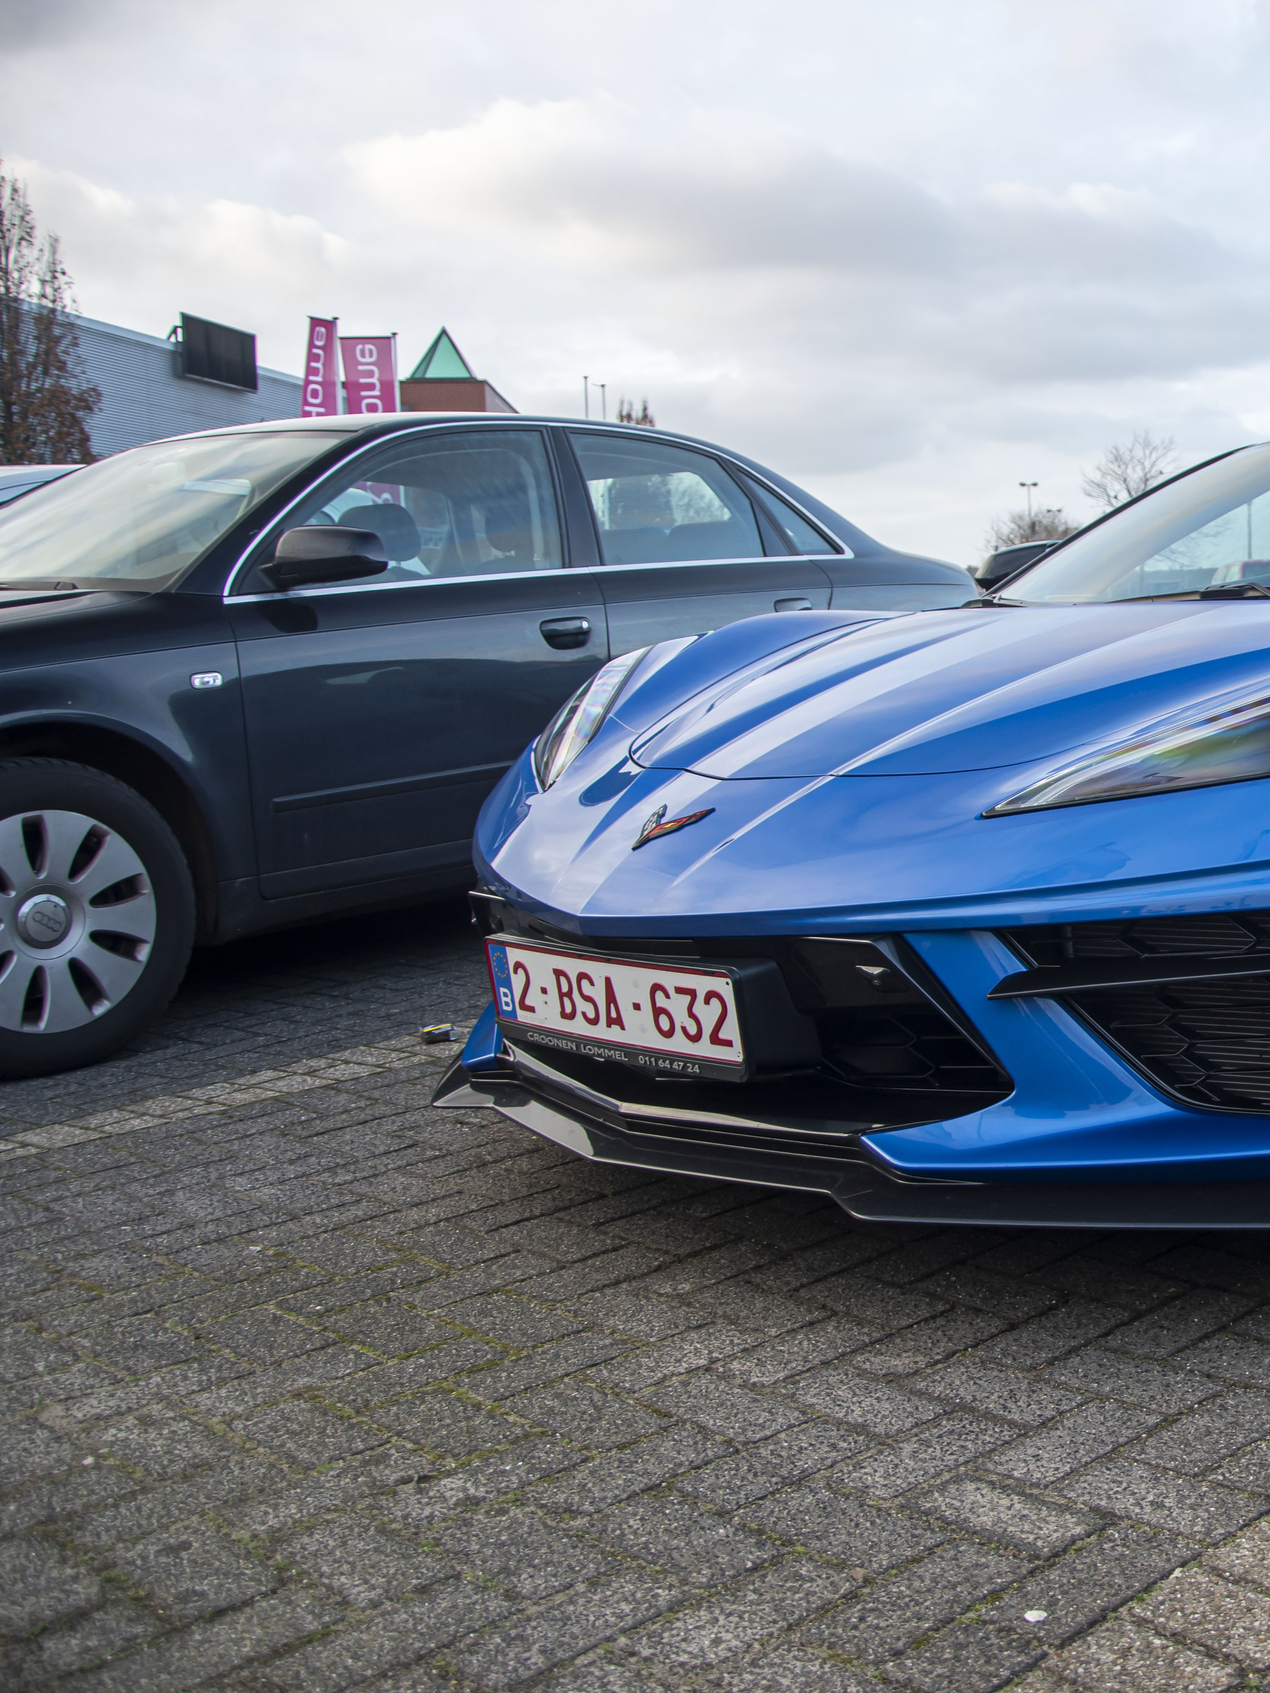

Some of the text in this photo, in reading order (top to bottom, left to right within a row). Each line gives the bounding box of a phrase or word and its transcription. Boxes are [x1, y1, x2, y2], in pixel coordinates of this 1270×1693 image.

[499, 987, 513, 1011] B
[527, 1032, 700, 1073] CROONEN LOMMEL 011 64 47 24
